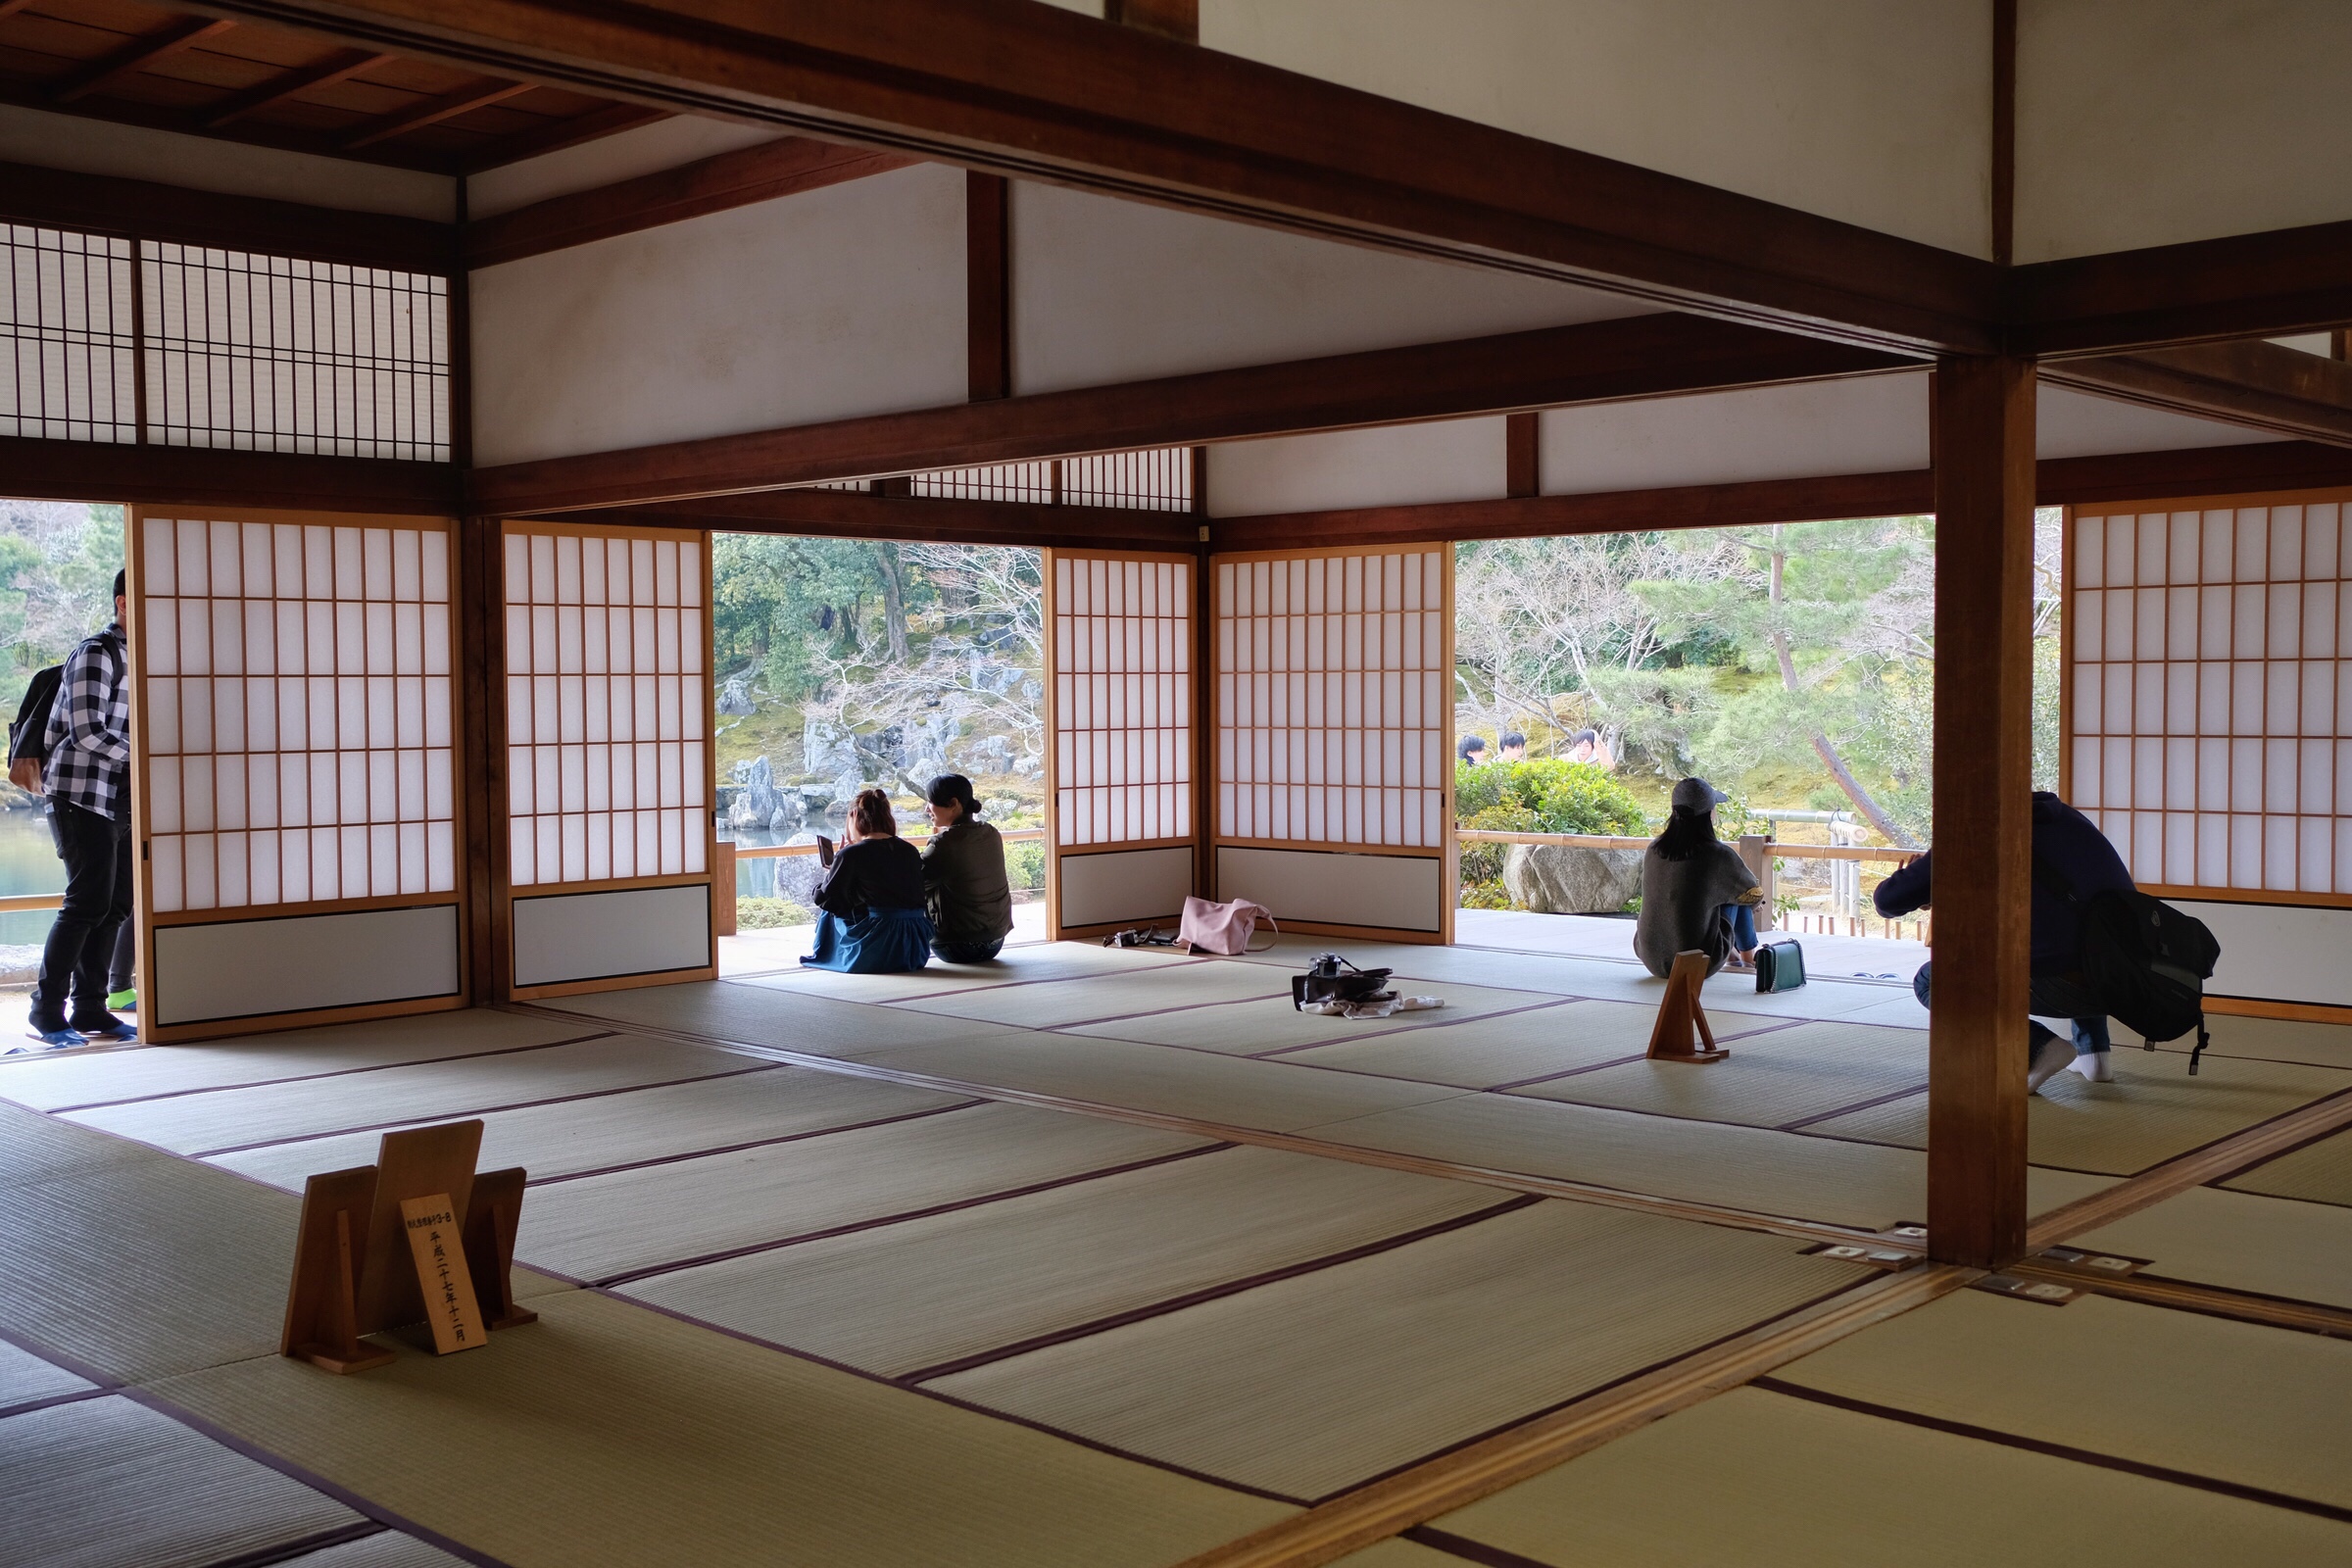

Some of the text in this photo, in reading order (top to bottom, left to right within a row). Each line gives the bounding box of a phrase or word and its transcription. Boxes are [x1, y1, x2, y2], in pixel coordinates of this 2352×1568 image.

[429, 1231, 466, 1343] 平成二十七年十二月
